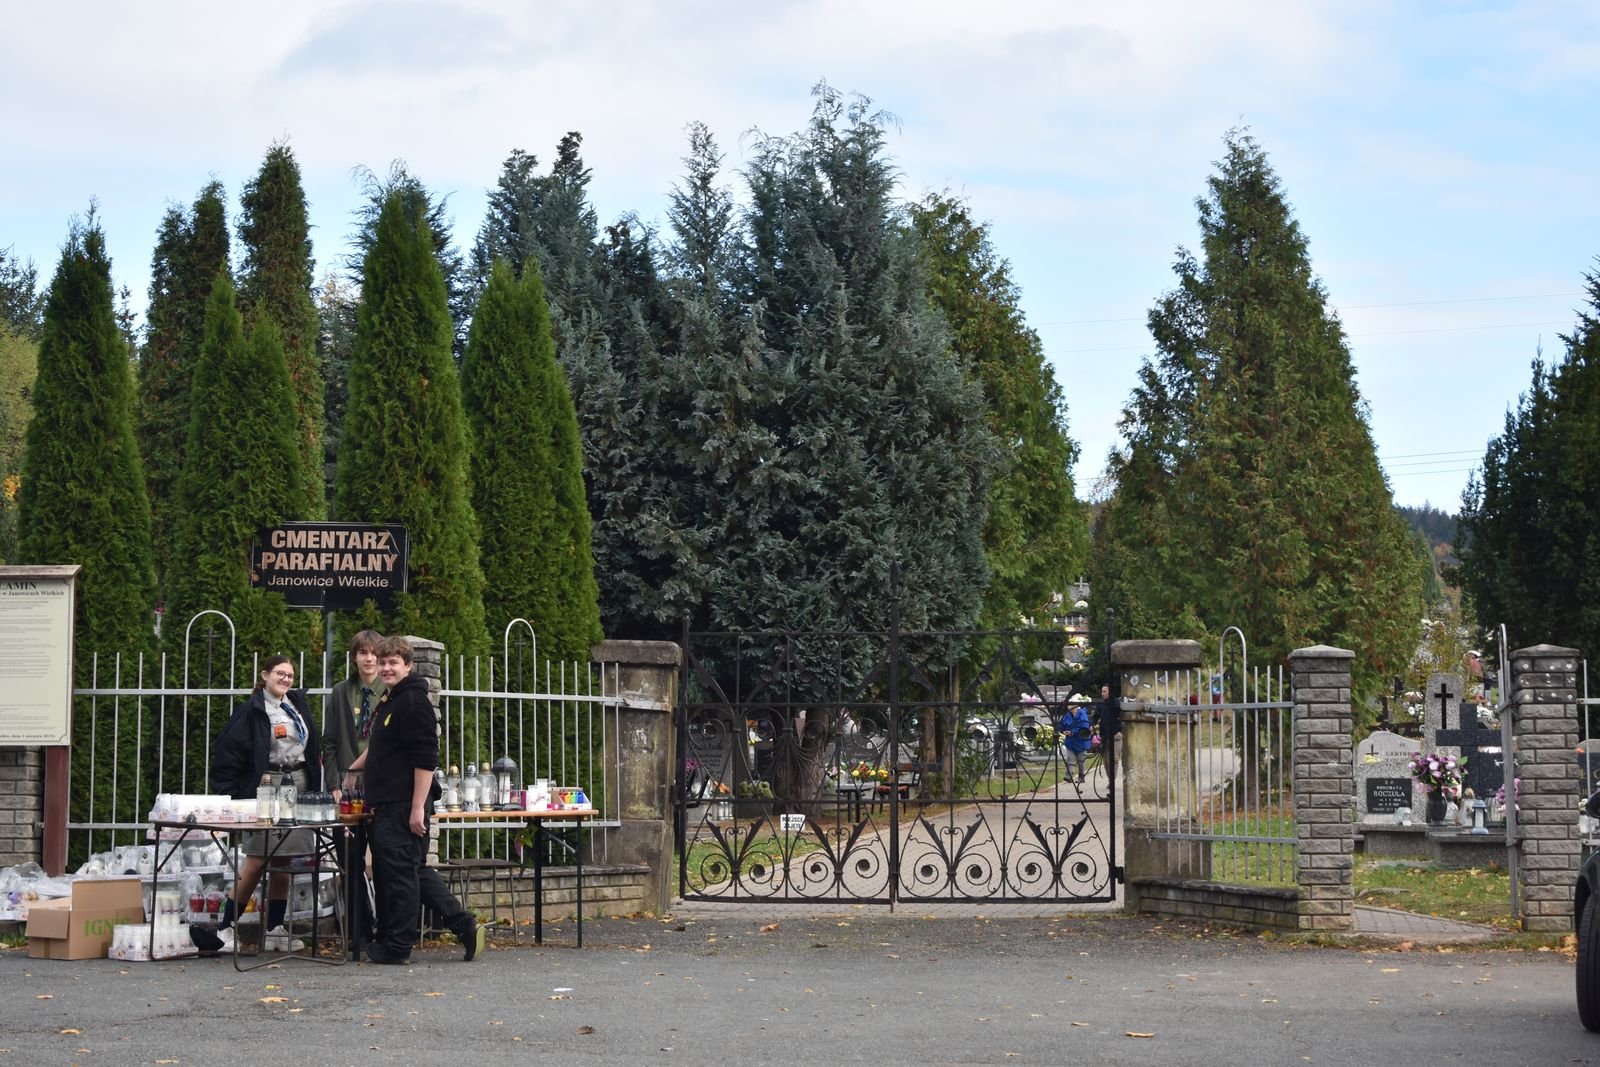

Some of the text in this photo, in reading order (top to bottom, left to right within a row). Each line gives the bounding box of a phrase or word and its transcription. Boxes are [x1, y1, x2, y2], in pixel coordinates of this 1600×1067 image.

[271, 529, 390, 549] CMENTARZ
[261, 551, 398, 572] PARAFIALNY
[268, 574, 389, 588] Janowice Wielkie
